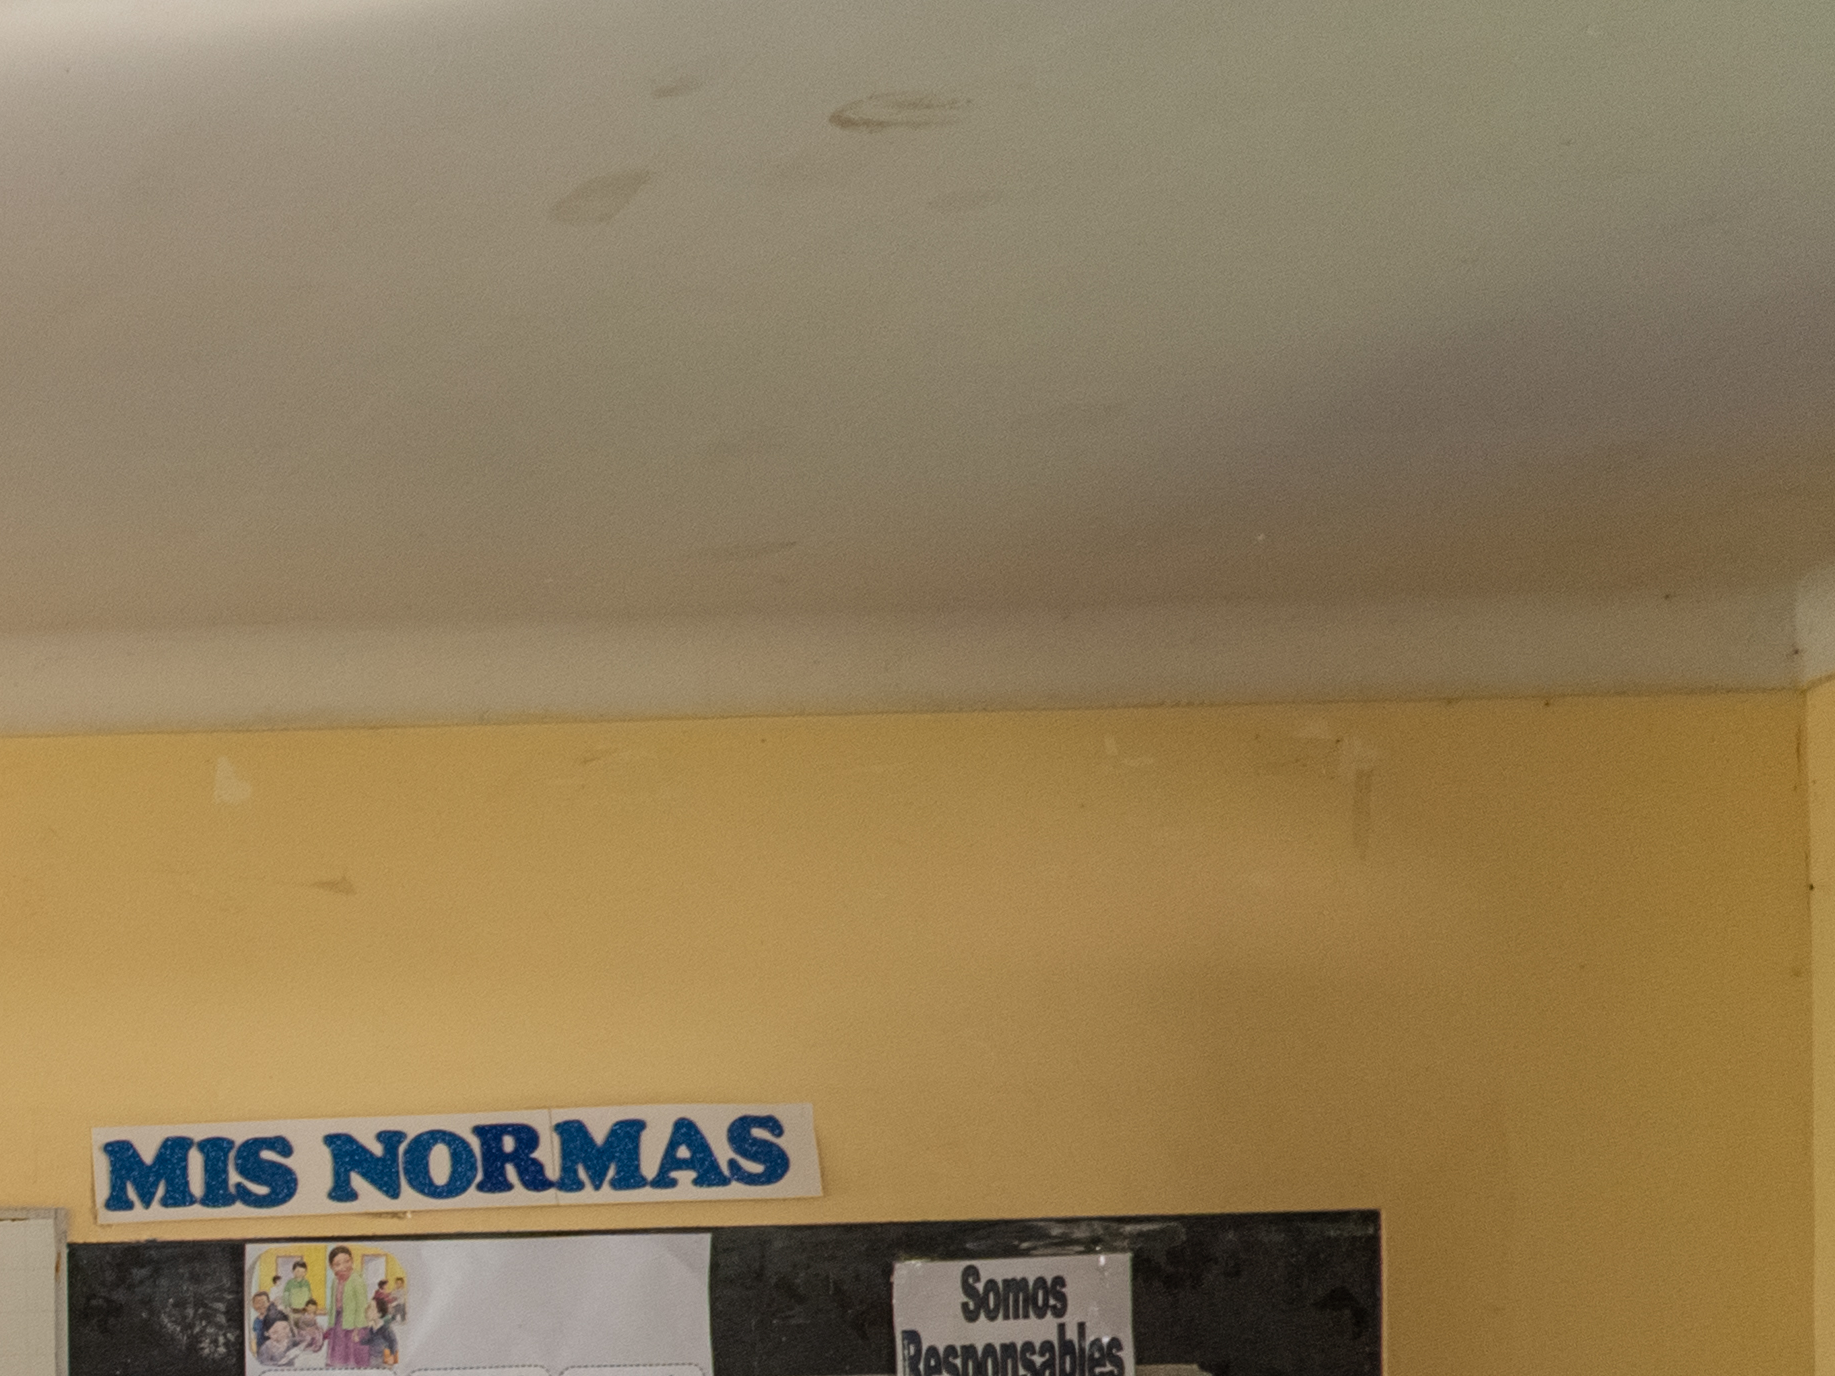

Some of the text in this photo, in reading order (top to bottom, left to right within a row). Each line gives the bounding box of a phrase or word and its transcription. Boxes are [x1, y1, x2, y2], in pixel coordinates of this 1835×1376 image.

[103, 1115, 791, 1211] MIS NORMAS
[960, 1264, 1069, 1324] Somos
